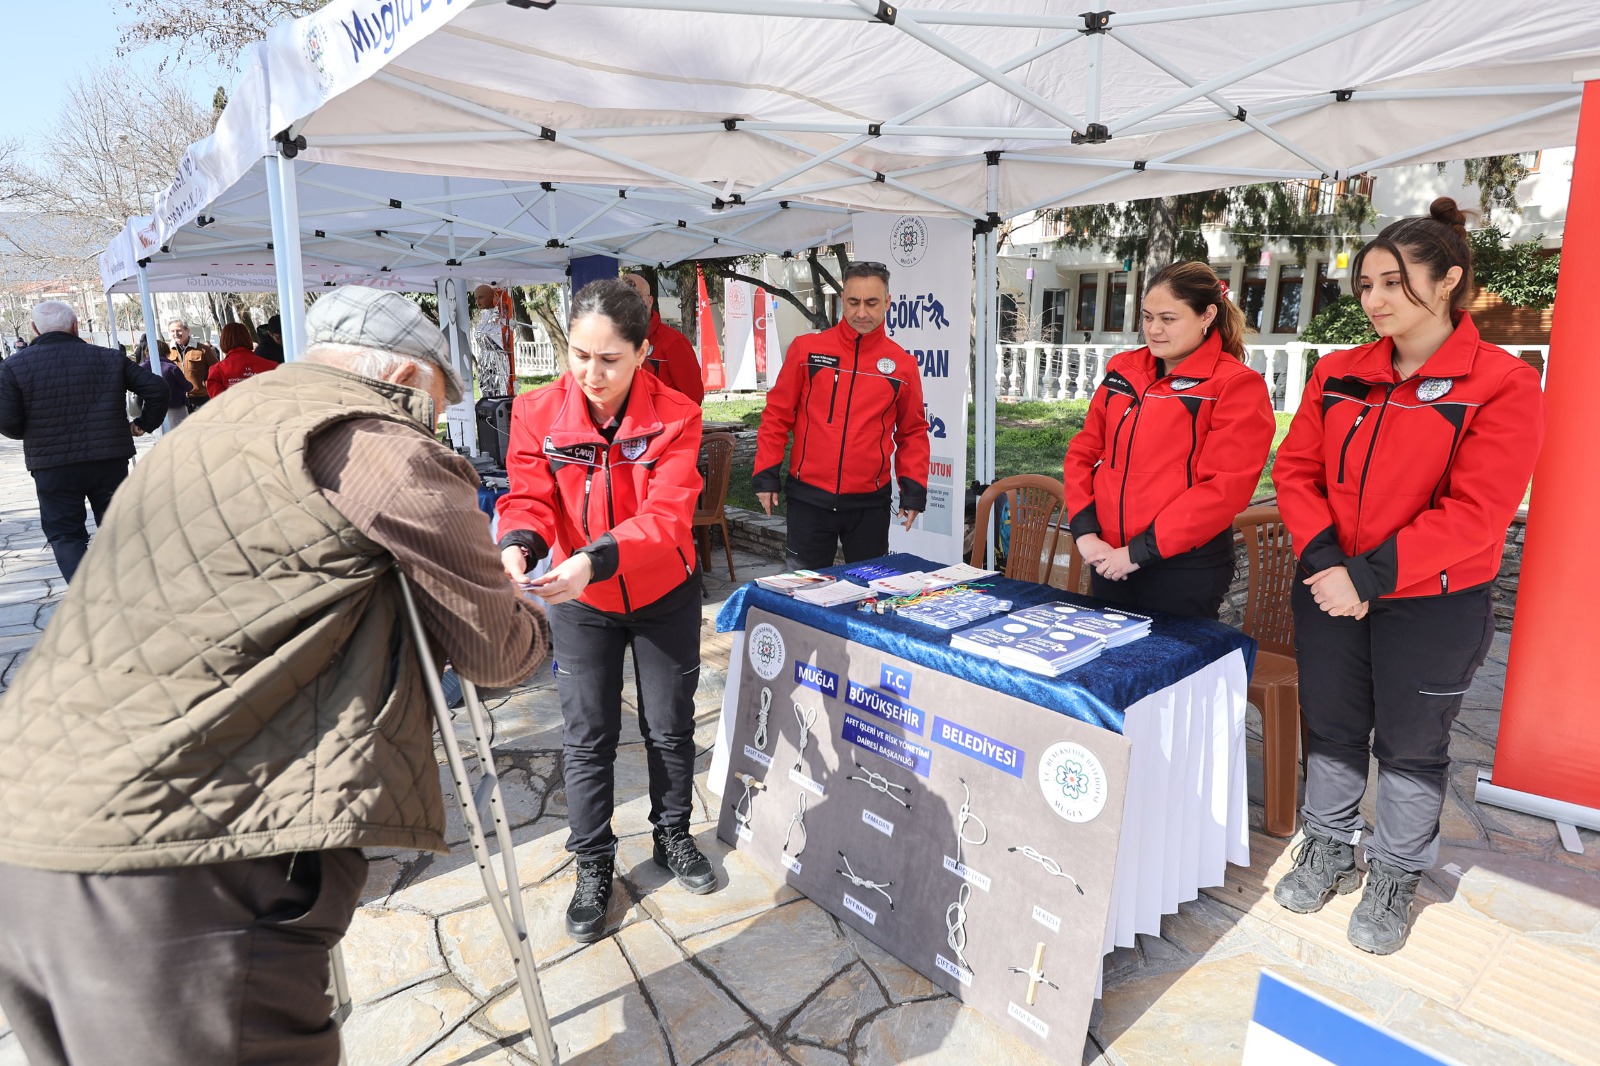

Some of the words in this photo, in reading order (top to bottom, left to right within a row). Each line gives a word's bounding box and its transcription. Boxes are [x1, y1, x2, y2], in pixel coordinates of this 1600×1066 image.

[886, 294, 920, 337] ÇÖK
[575, 447, 593, 461] ÇAVUŞ
[885, 670, 906, 690] T.C.
[798, 665, 835, 691] MUĞLA
[849, 686, 920, 728] BÜYÜKŞEHİR
[942, 723, 1017, 768] BELEDİYESİ
[845, 716, 859, 728] AFET
[860, 720, 876, 735] İŞLERİ
[876, 729, 884, 740] VE
[884, 732, 898, 746] RİSK
[898, 739, 930, 760] YÖNETİMİ
[856, 735, 879, 751] DAİRESİ
[879, 745, 914, 768] BAŞKANLIĞI
[865, 812, 890, 831] CAMADAN
[945, 858, 970, 876] İZBRÇO
[1010, 1005, 1026, 1019] TAM
